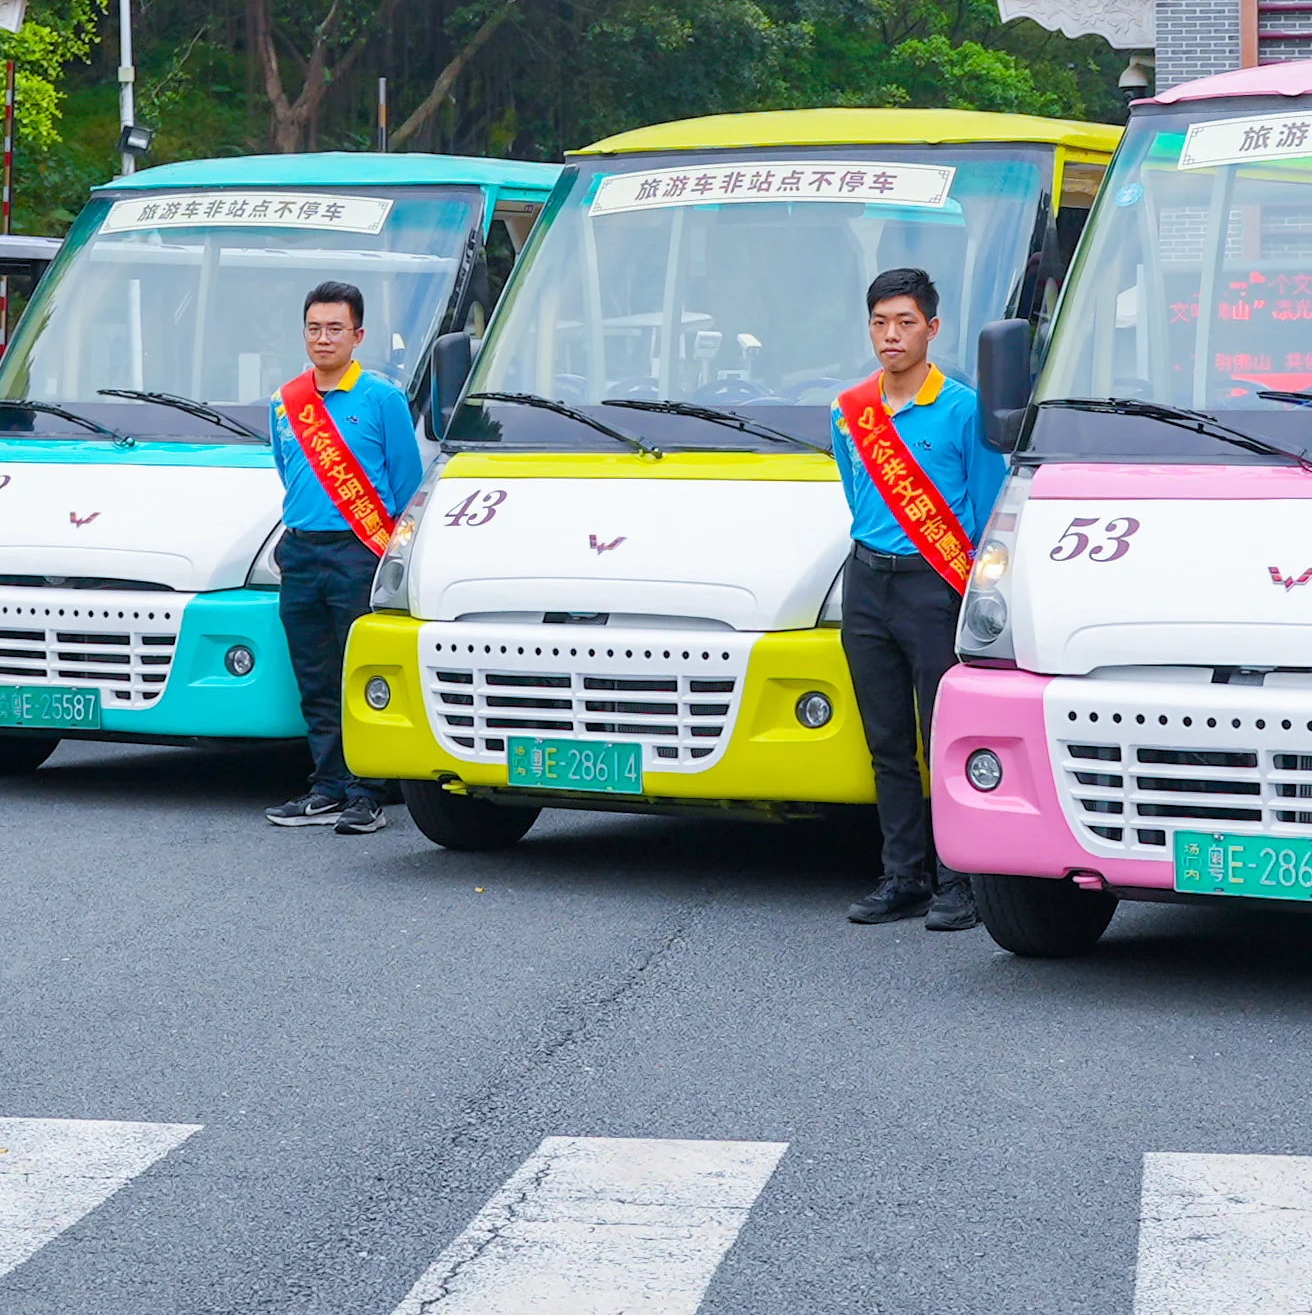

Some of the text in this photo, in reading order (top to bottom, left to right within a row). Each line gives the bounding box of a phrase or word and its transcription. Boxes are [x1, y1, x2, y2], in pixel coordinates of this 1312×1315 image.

[634, 170, 899, 202] 旅游车非站点不停车
[136, 199, 346, 223] 旅游车非站点不停车
[443, 489, 508, 527] 43
[1049, 516, 1141, 563] 53
[530, 746, 637, 783] 粤E-28614
